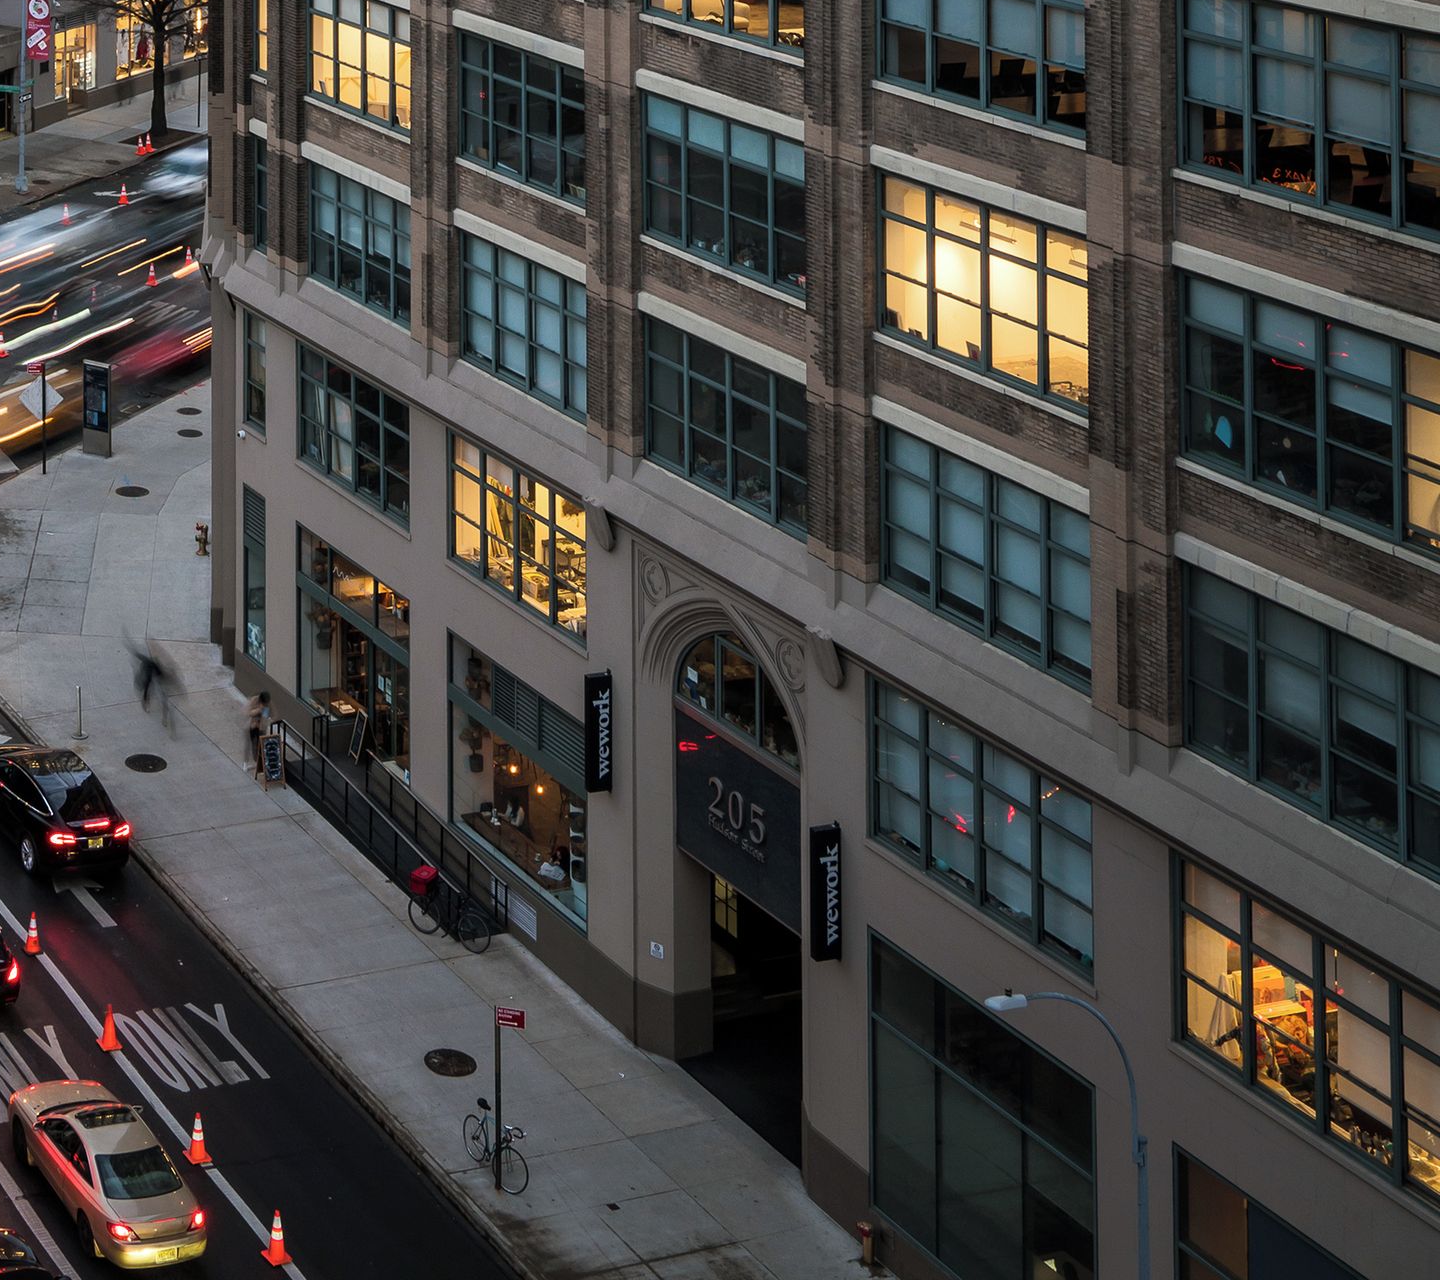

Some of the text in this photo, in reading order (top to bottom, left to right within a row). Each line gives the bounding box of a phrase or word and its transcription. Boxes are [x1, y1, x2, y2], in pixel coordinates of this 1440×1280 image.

[592, 688, 610, 780] wework
[708, 777, 766, 844] 205
[819, 843, 839, 946] wework
[113, 1003, 271, 1093] ONLY
